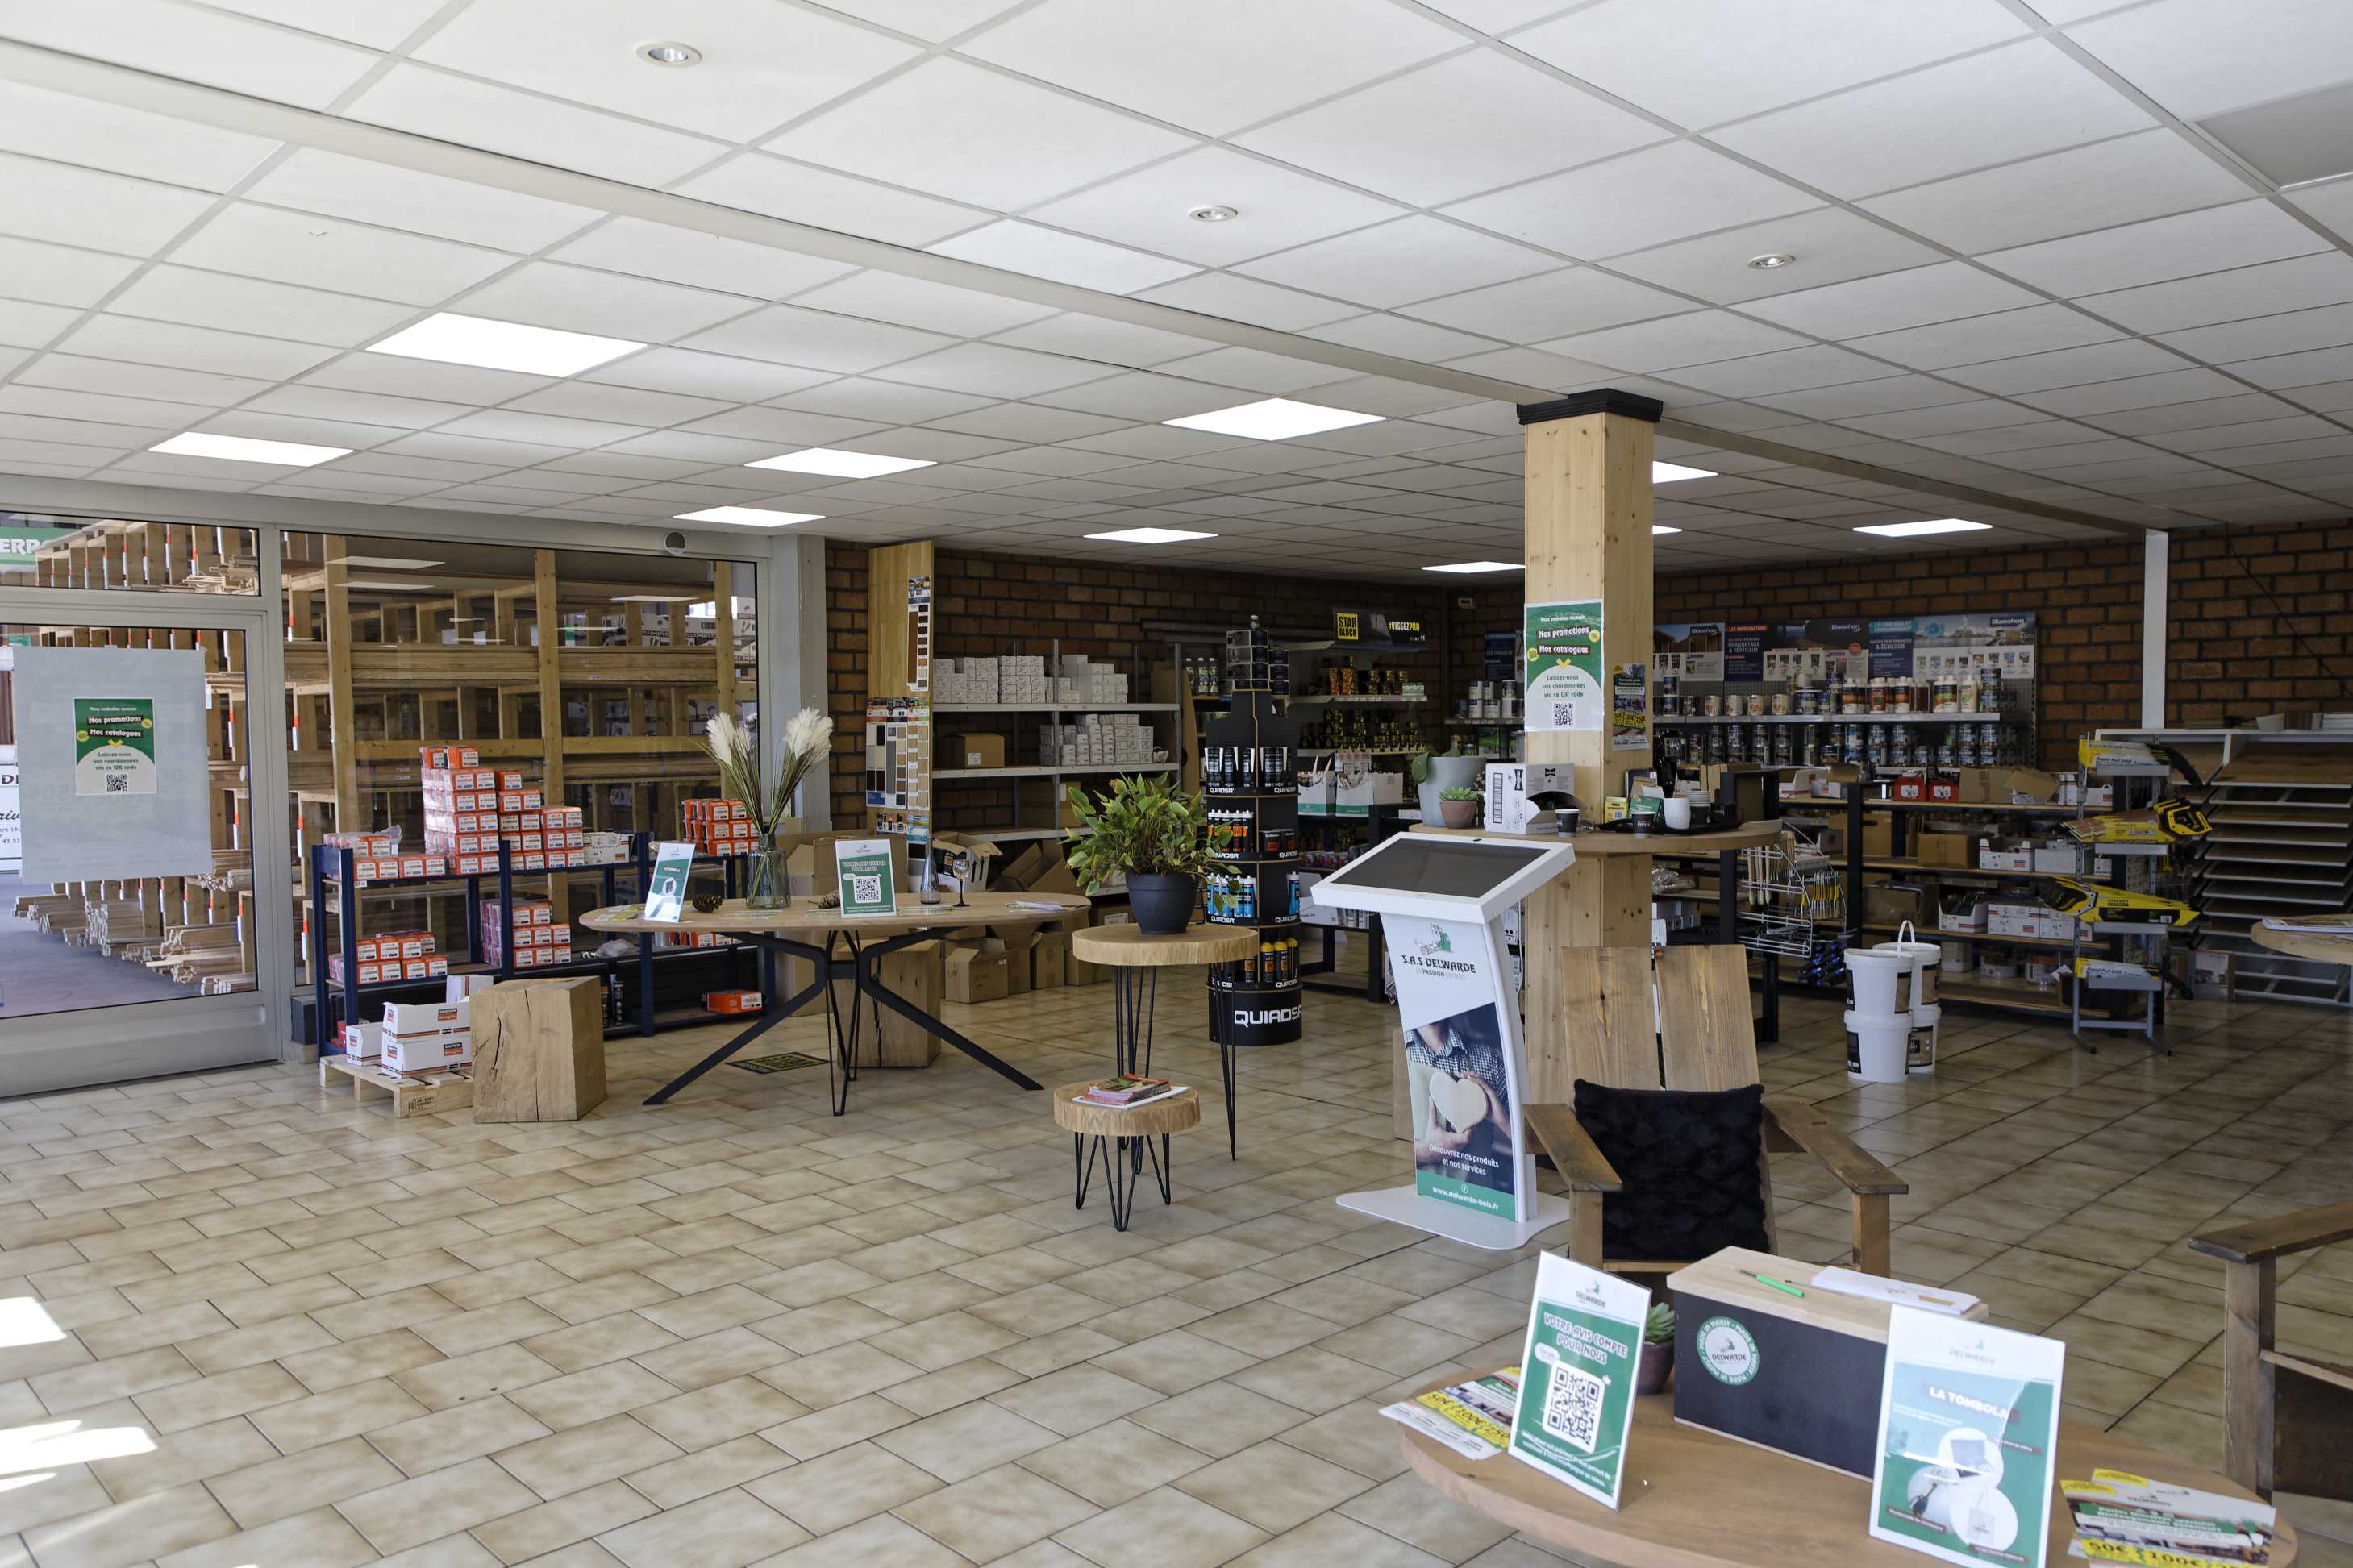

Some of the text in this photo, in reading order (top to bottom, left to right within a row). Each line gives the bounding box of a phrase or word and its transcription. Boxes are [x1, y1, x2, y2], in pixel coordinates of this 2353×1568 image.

[1339, 617, 1356, 627] STAR
[1388, 621, 1420, 631] #VISSEZPRO
[1339, 628, 1357, 637] BLOCK
[1538, 626, 1589, 638] Nos promotions
[1539, 645, 1589, 655] Nos catalogues
[103, 715, 142, 725] promotions
[105, 729, 141, 737] catalogues
[1401, 954, 1476, 974] S.A.S DELWARDE
[1422, 968, 1445, 977] PASSION
[1429, 1142, 1500, 1168] Découvrez nos produits
[1450, 1161, 1462, 1169] nos
[1462, 1162, 1486, 1175] services
[1544, 1312, 1628, 1359] VOTRE AVIS COMPTE
[1556, 1333, 1583, 1355] POUR
[1583, 1343, 1608, 1366] NOUS
[1948, 1348, 1996, 1366] DELWARDE
[1929, 1386, 1945, 1400] LA
[1948, 1391, 2009, 1420] TOMBOLA
